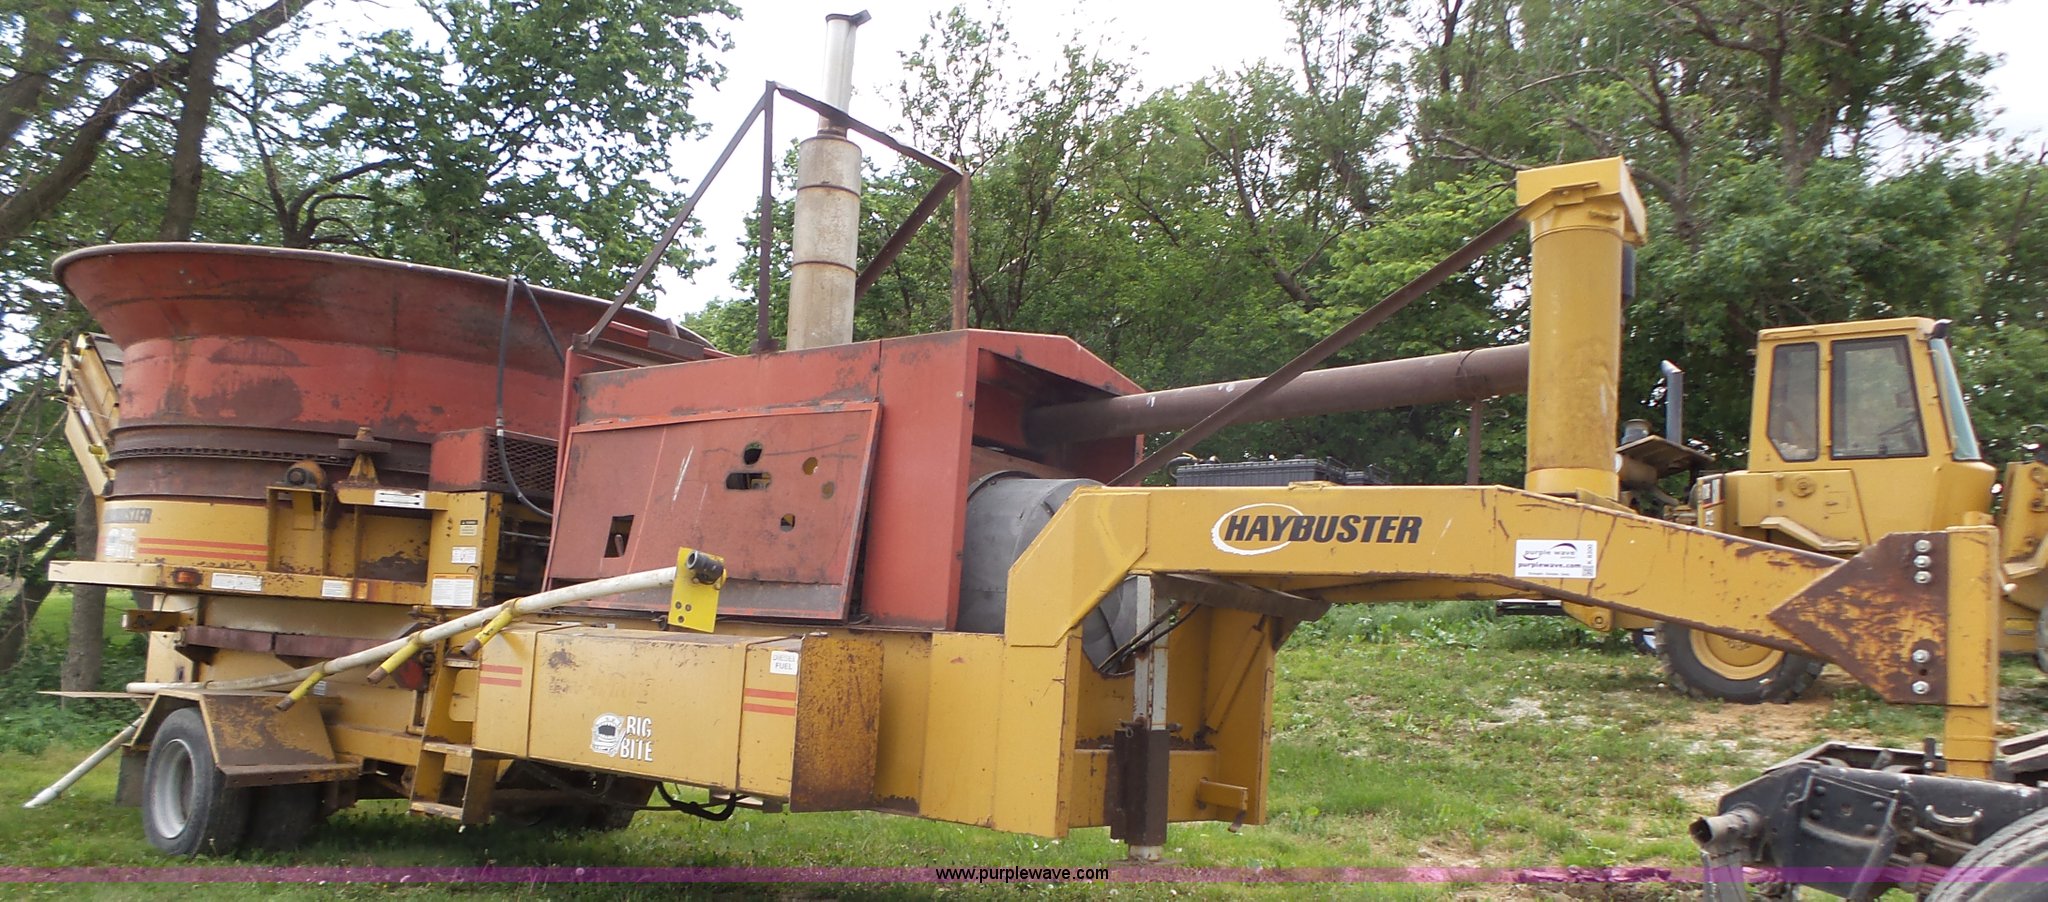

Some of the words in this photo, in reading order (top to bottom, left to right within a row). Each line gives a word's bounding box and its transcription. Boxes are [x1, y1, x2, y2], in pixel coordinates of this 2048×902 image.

[1224, 514, 1423, 544] HAYBUSTER
[775, 662, 793, 671] FUEL
[620, 738, 654, 762] BITE
